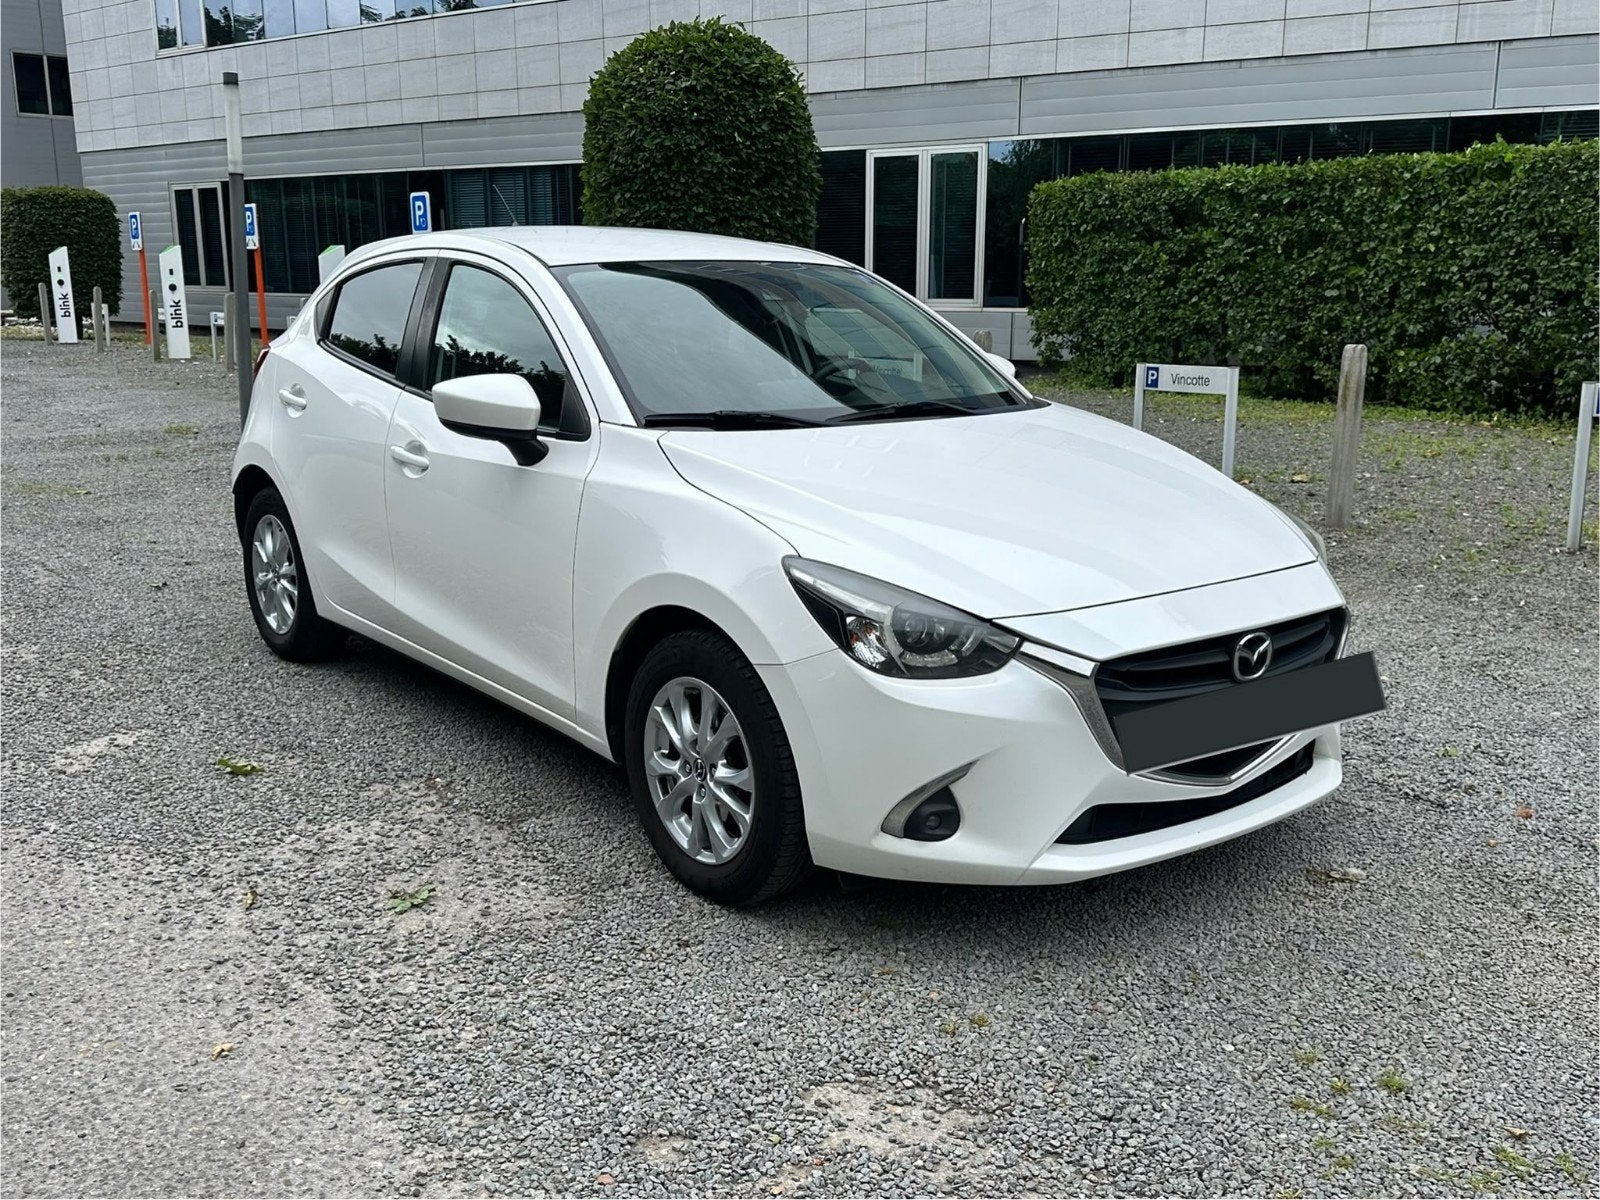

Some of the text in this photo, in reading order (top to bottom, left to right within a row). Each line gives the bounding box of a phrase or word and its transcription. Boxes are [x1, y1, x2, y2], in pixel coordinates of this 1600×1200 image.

[245, 210, 252, 232] P
[415, 200, 424, 226] P
[131, 217, 137, 236] P
[59, 293, 71, 318] blink
[169, 299, 184, 329] blink
[1147, 370, 1211, 387] P Vincotte
